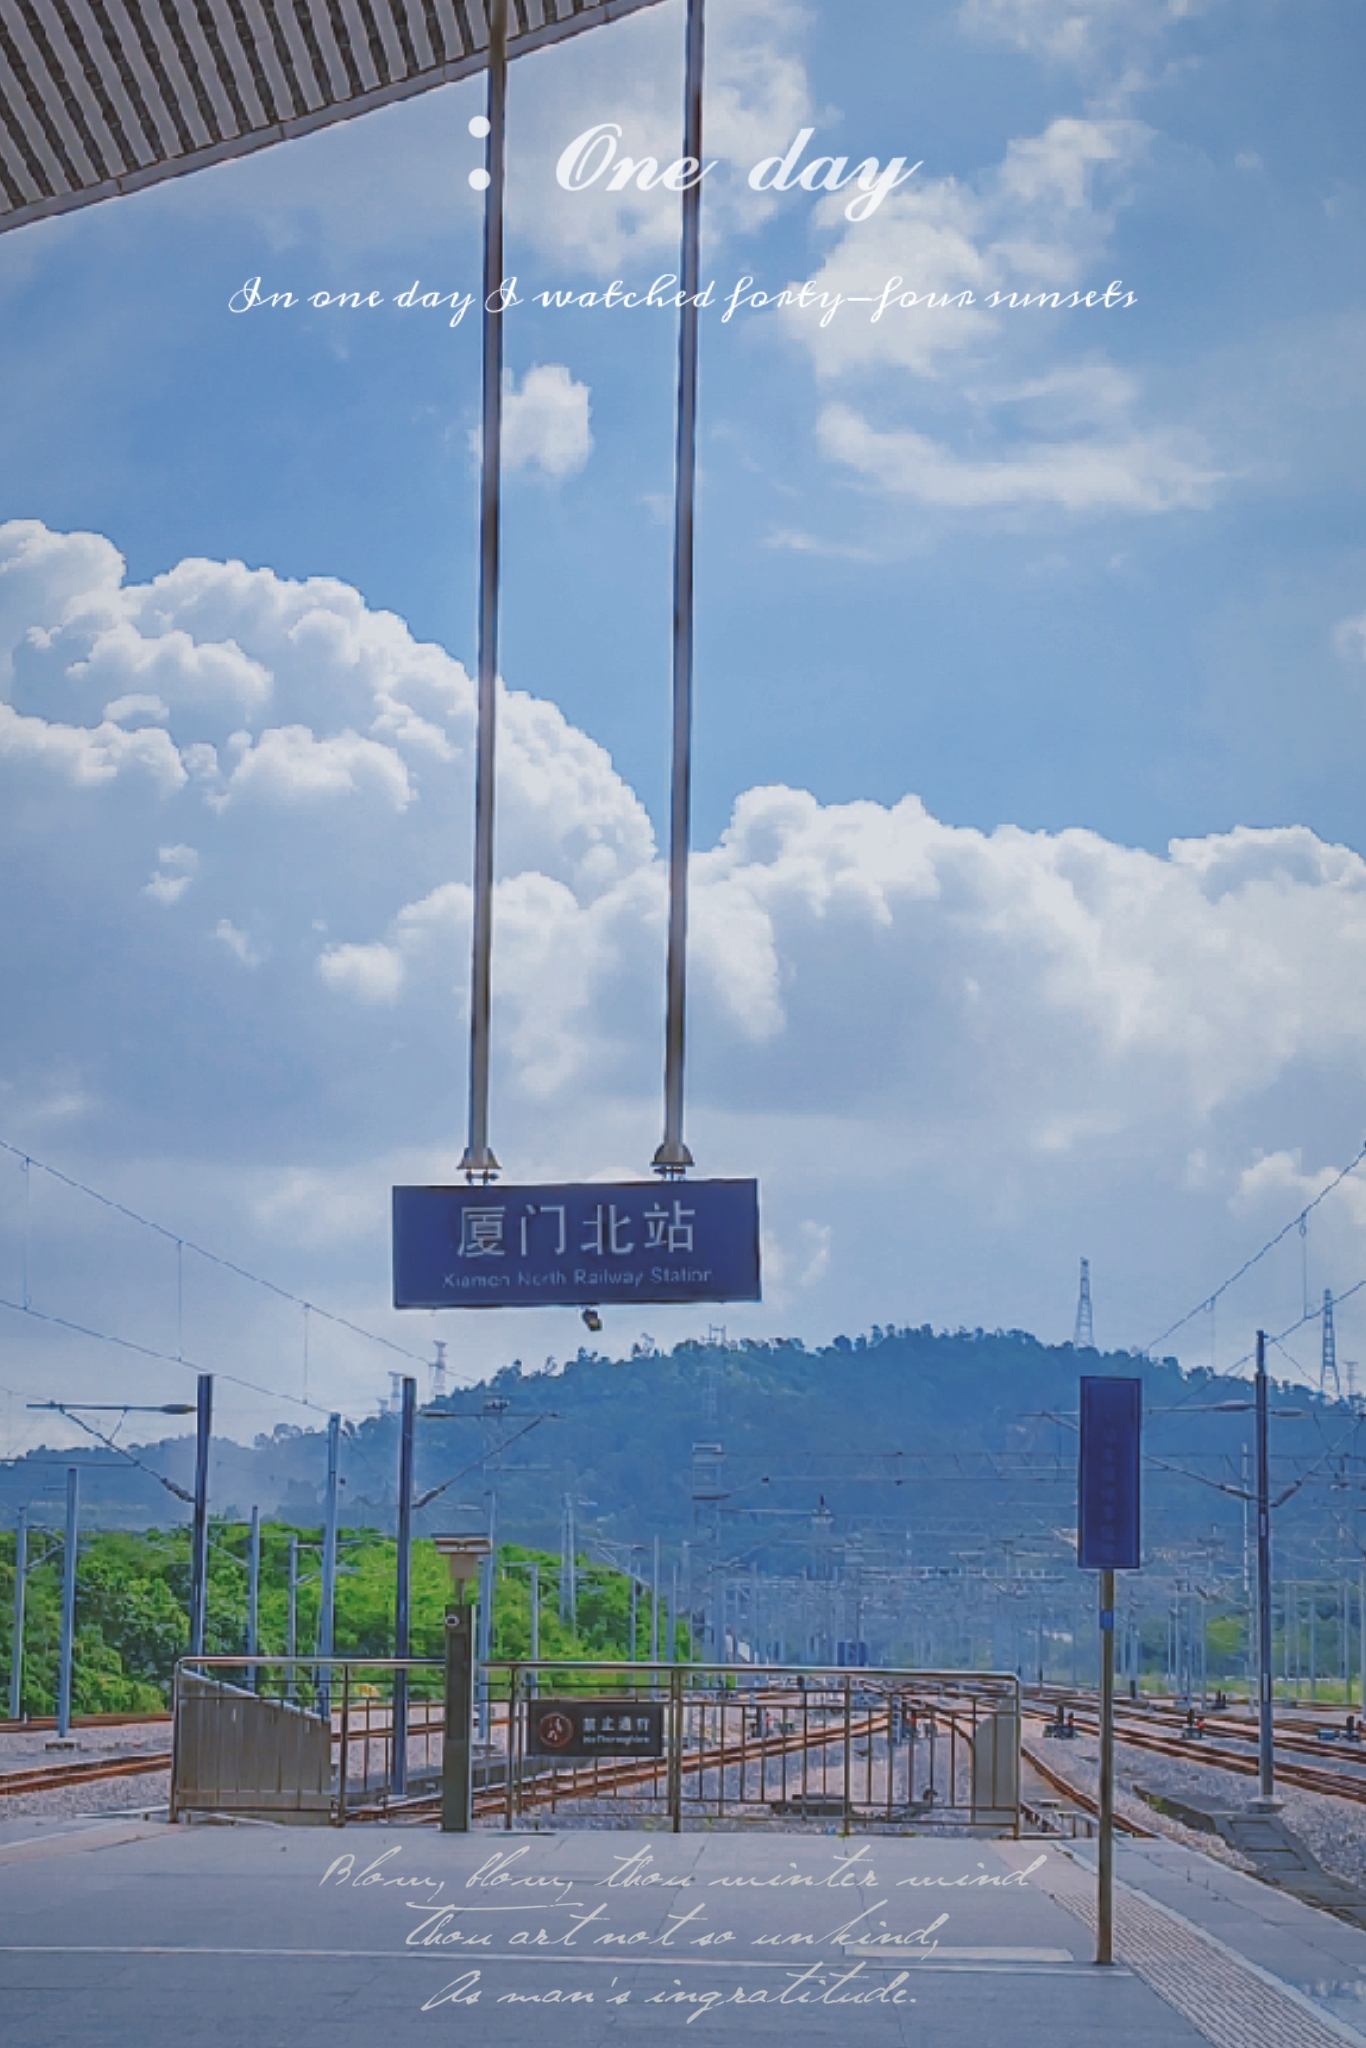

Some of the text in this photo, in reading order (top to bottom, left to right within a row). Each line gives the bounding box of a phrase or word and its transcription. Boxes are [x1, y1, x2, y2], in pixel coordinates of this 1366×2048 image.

[457, 1200, 695, 1257] 厦门北站
[442, 1265, 711, 1289] Xiamen North Railway Station
